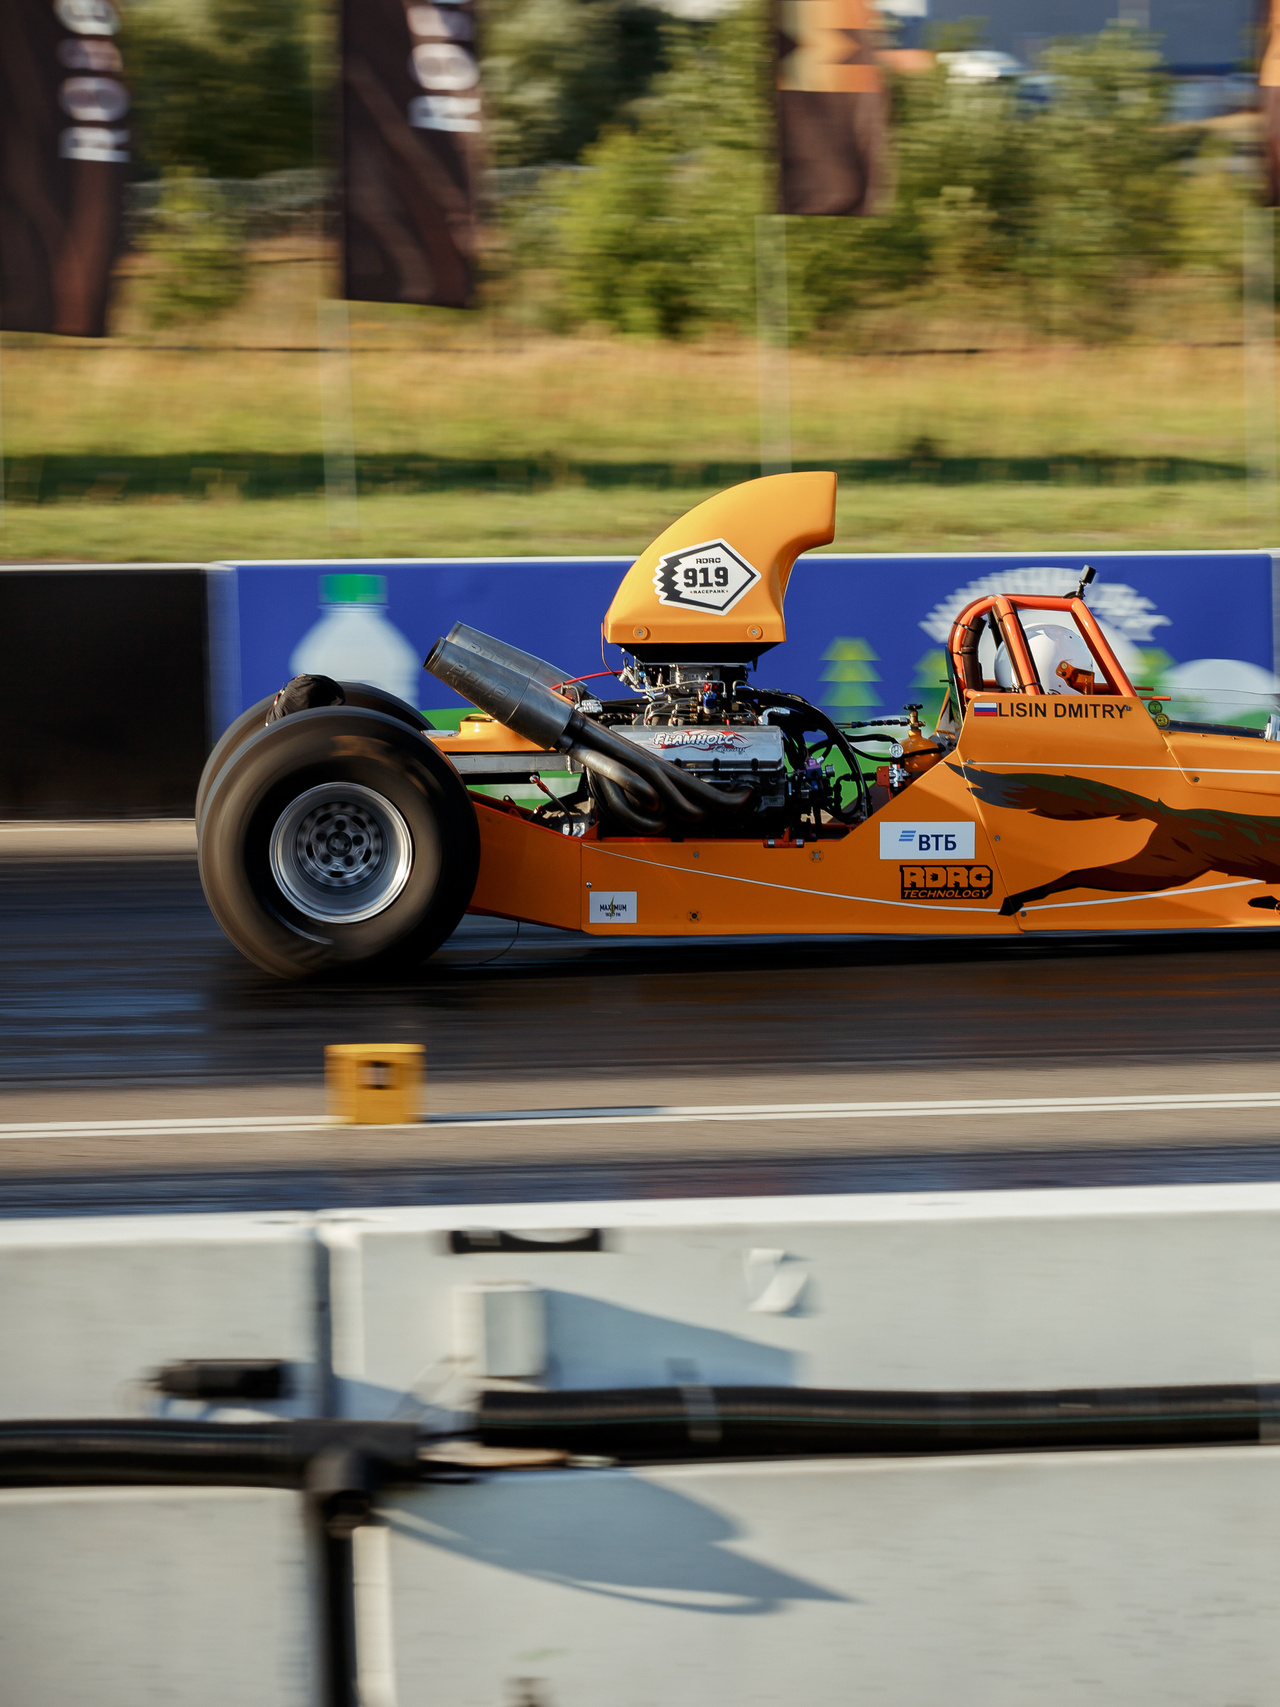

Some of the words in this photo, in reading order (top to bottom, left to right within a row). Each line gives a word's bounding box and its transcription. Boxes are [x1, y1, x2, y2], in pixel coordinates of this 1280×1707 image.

[683, 566, 729, 588] 919
[998, 702, 1047, 718] LISIN
[1054, 703, 1127, 719] DMITRY
[918, 834, 957, 851] ВТБ
[902, 866, 991, 888] RDRC
[903, 889, 990, 898] TECHNOLOGY
